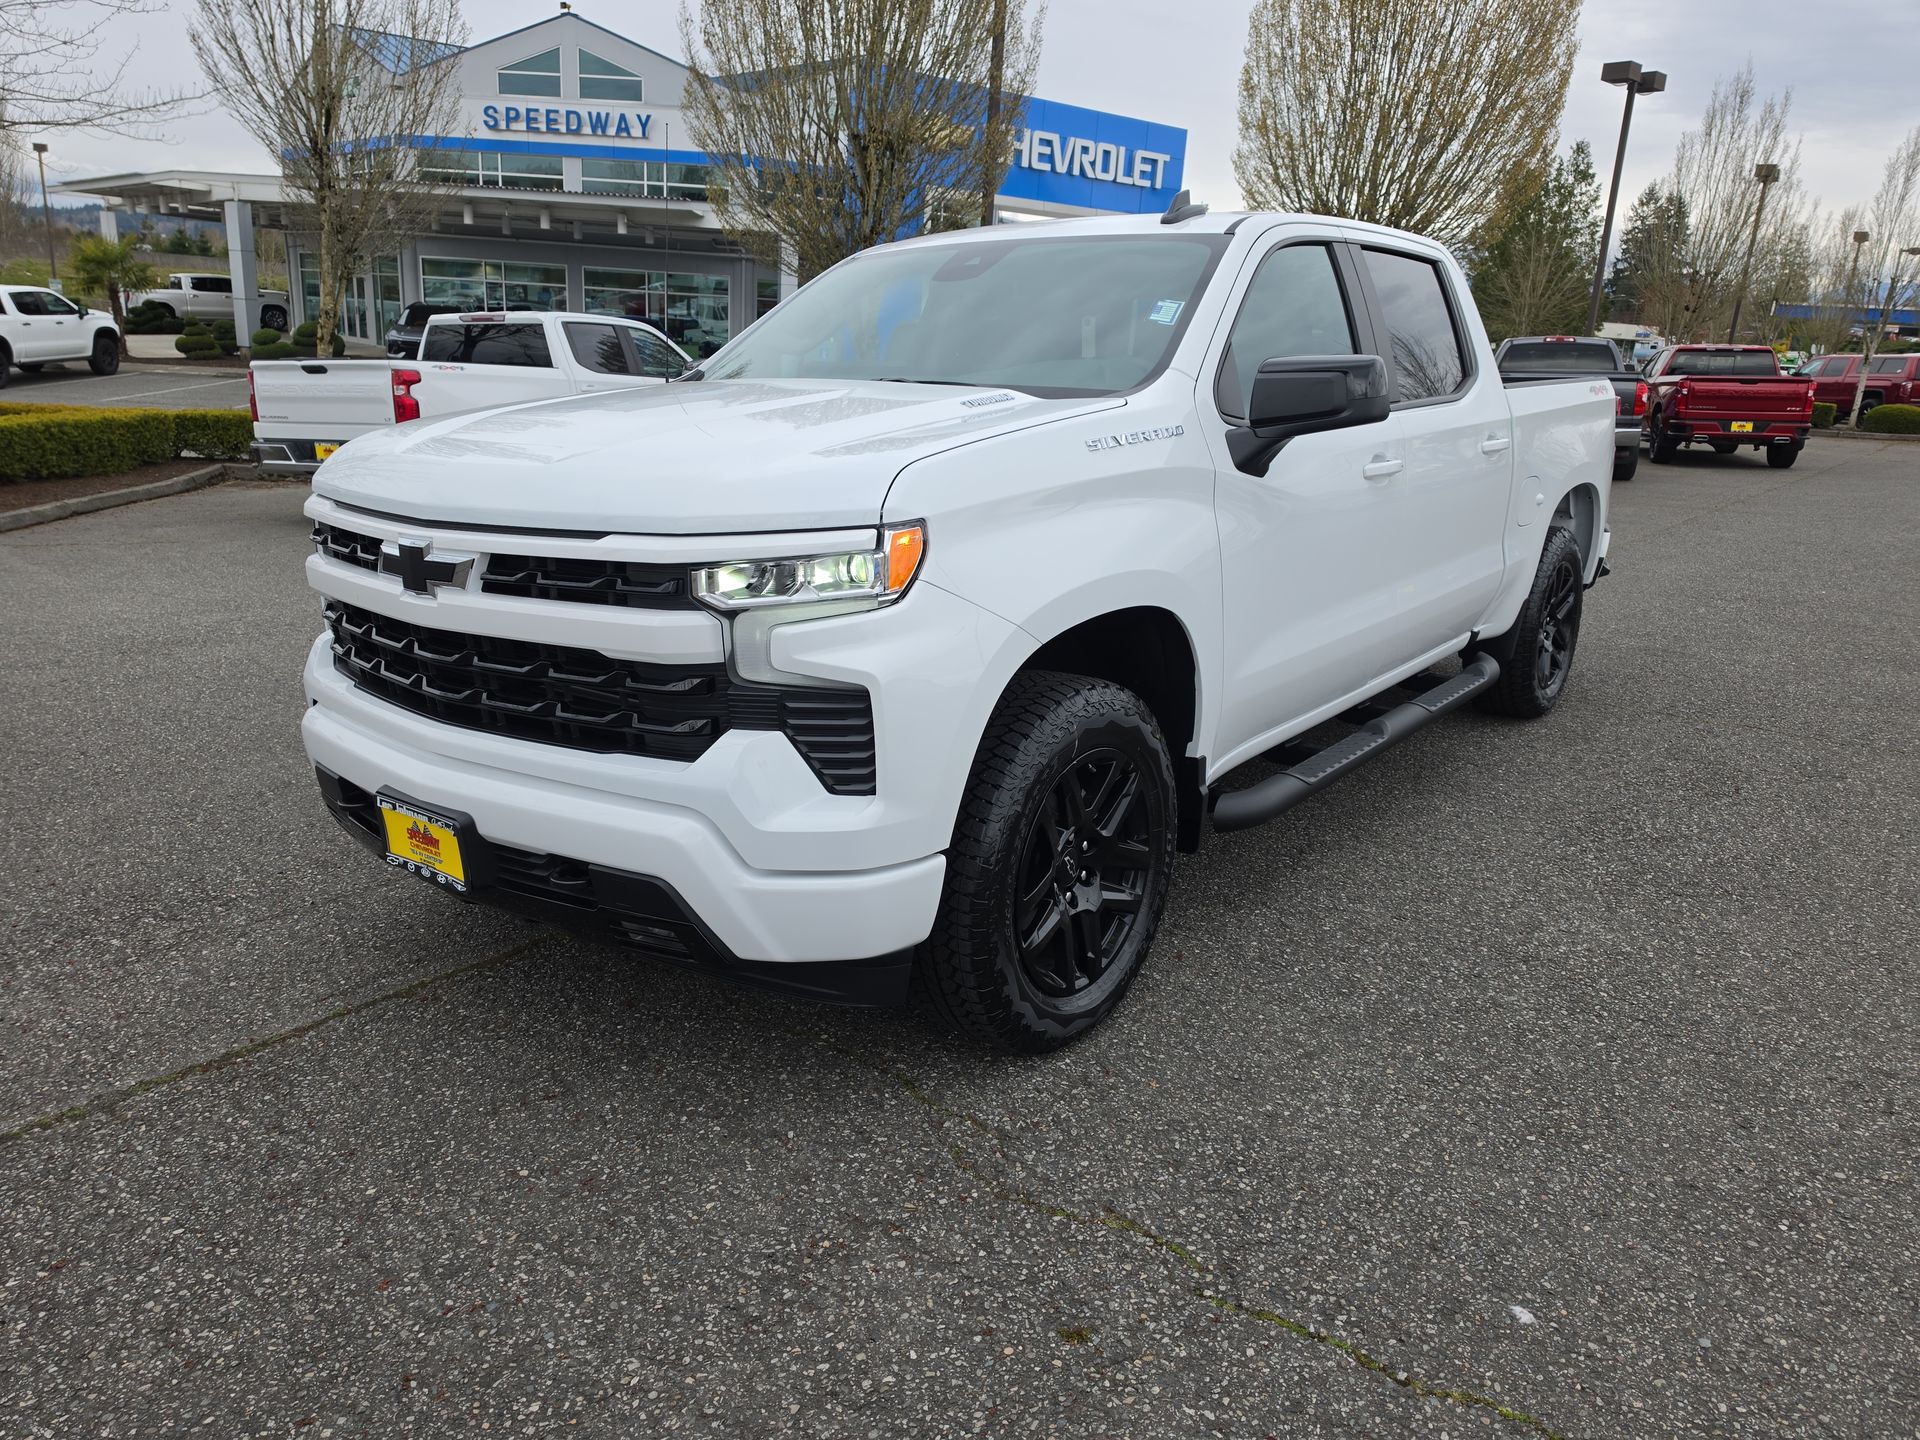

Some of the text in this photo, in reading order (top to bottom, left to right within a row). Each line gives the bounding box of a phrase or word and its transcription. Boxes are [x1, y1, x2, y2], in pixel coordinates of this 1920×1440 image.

[483, 105, 652, 138] SPEEDWAY
[1001, 127, 1171, 190] HEVROLET
[1086, 425, 1184, 451] SILVERADO
